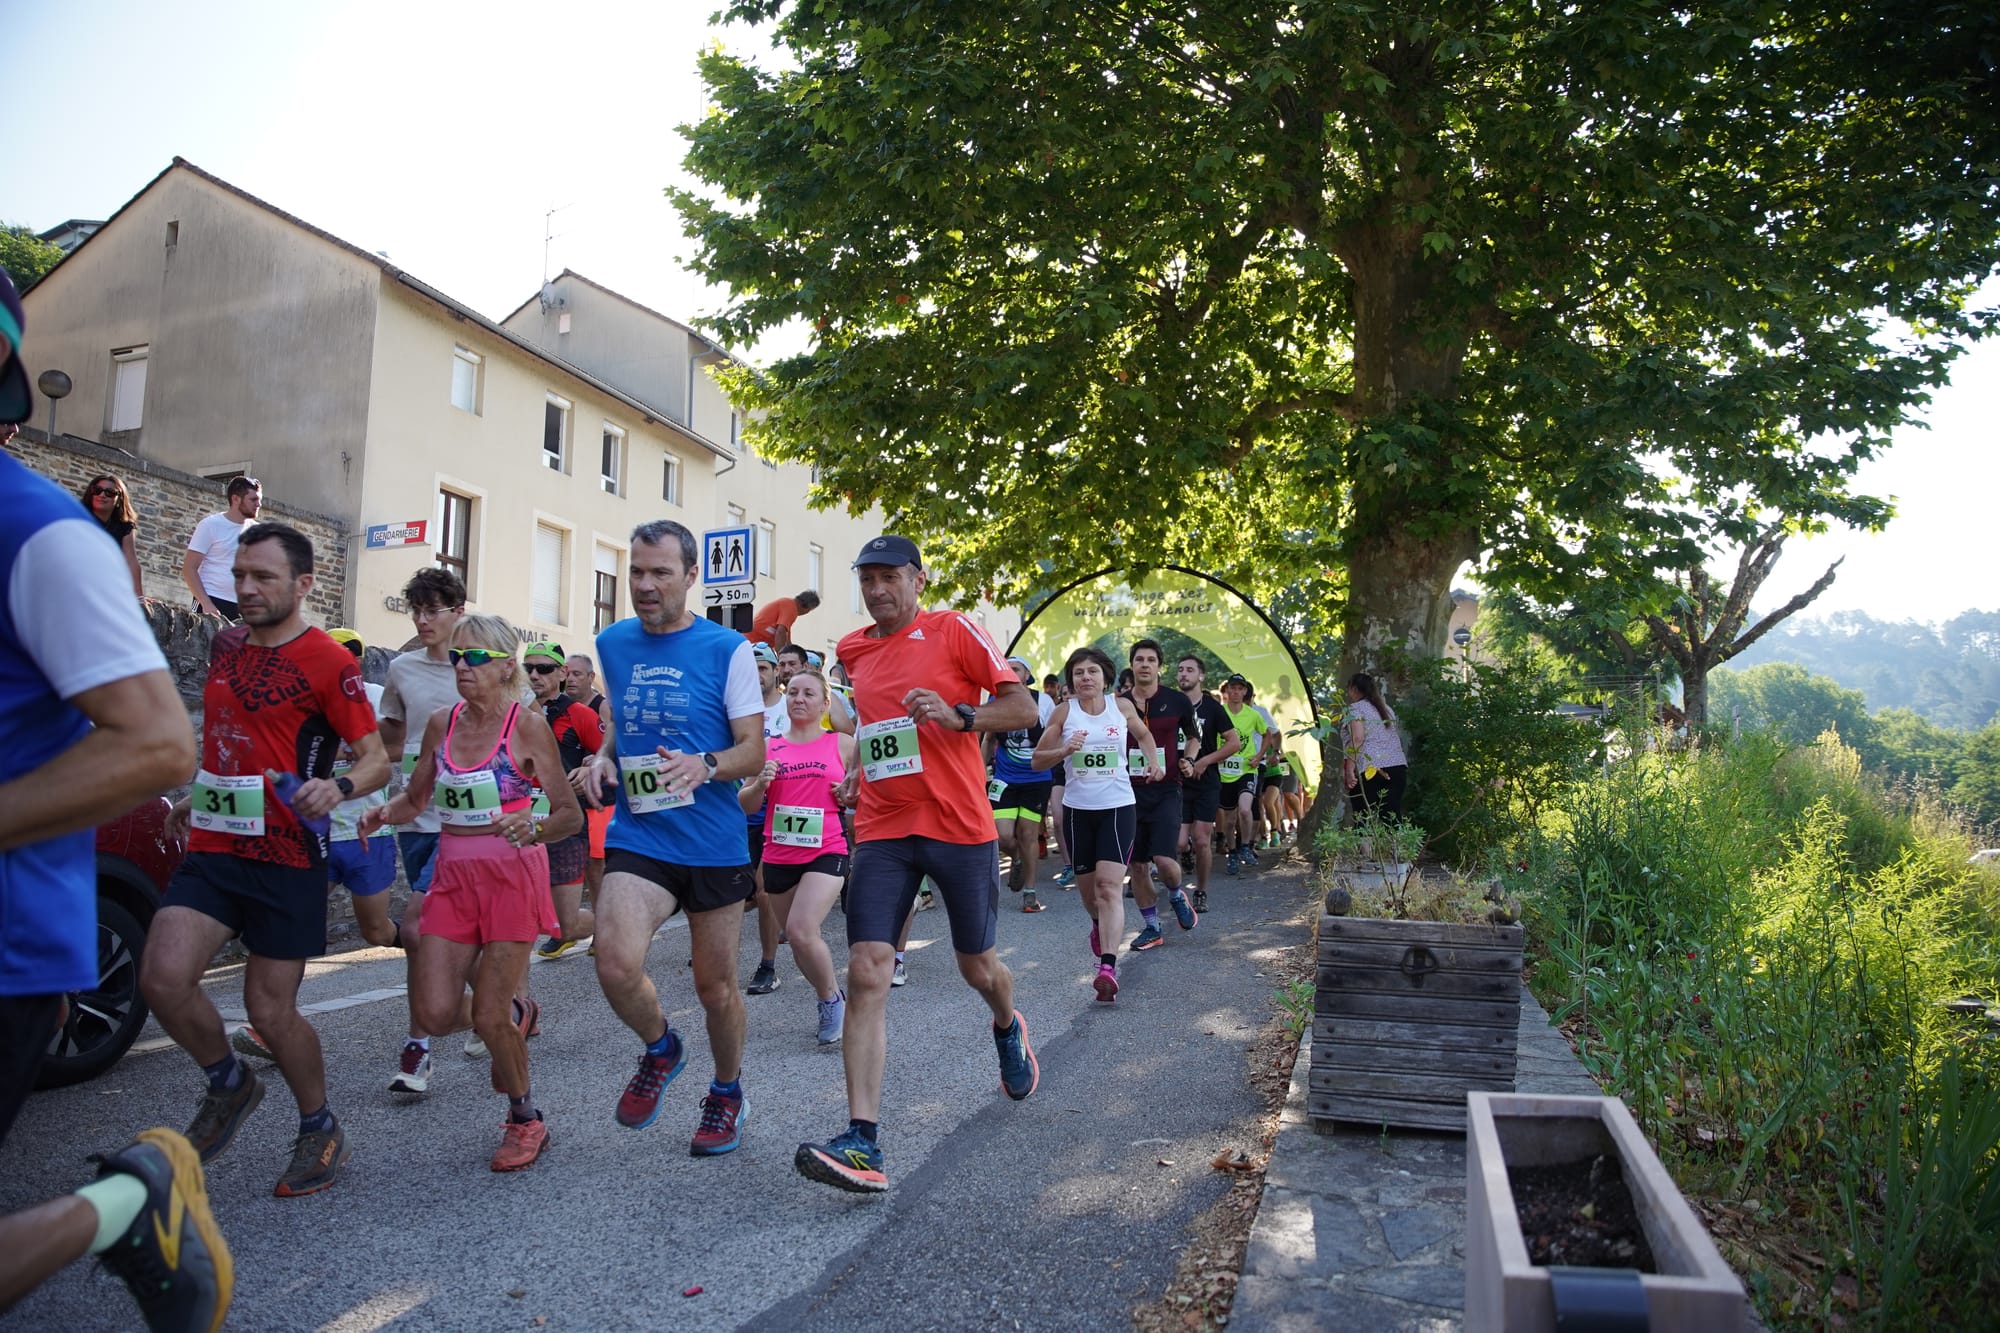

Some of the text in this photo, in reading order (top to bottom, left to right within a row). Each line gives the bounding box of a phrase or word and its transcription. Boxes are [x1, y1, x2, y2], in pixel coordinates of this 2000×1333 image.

[375, 528, 418, 541] GENDARMERIE
[870, 734, 899, 761] 88
[1083, 753, 1106, 768] 68
[628, 770, 668, 796] 10
[205, 788, 237, 816] 31
[444, 787, 476, 810] 81
[530, 797, 540, 811] 7
[783, 815, 809, 833] 17
